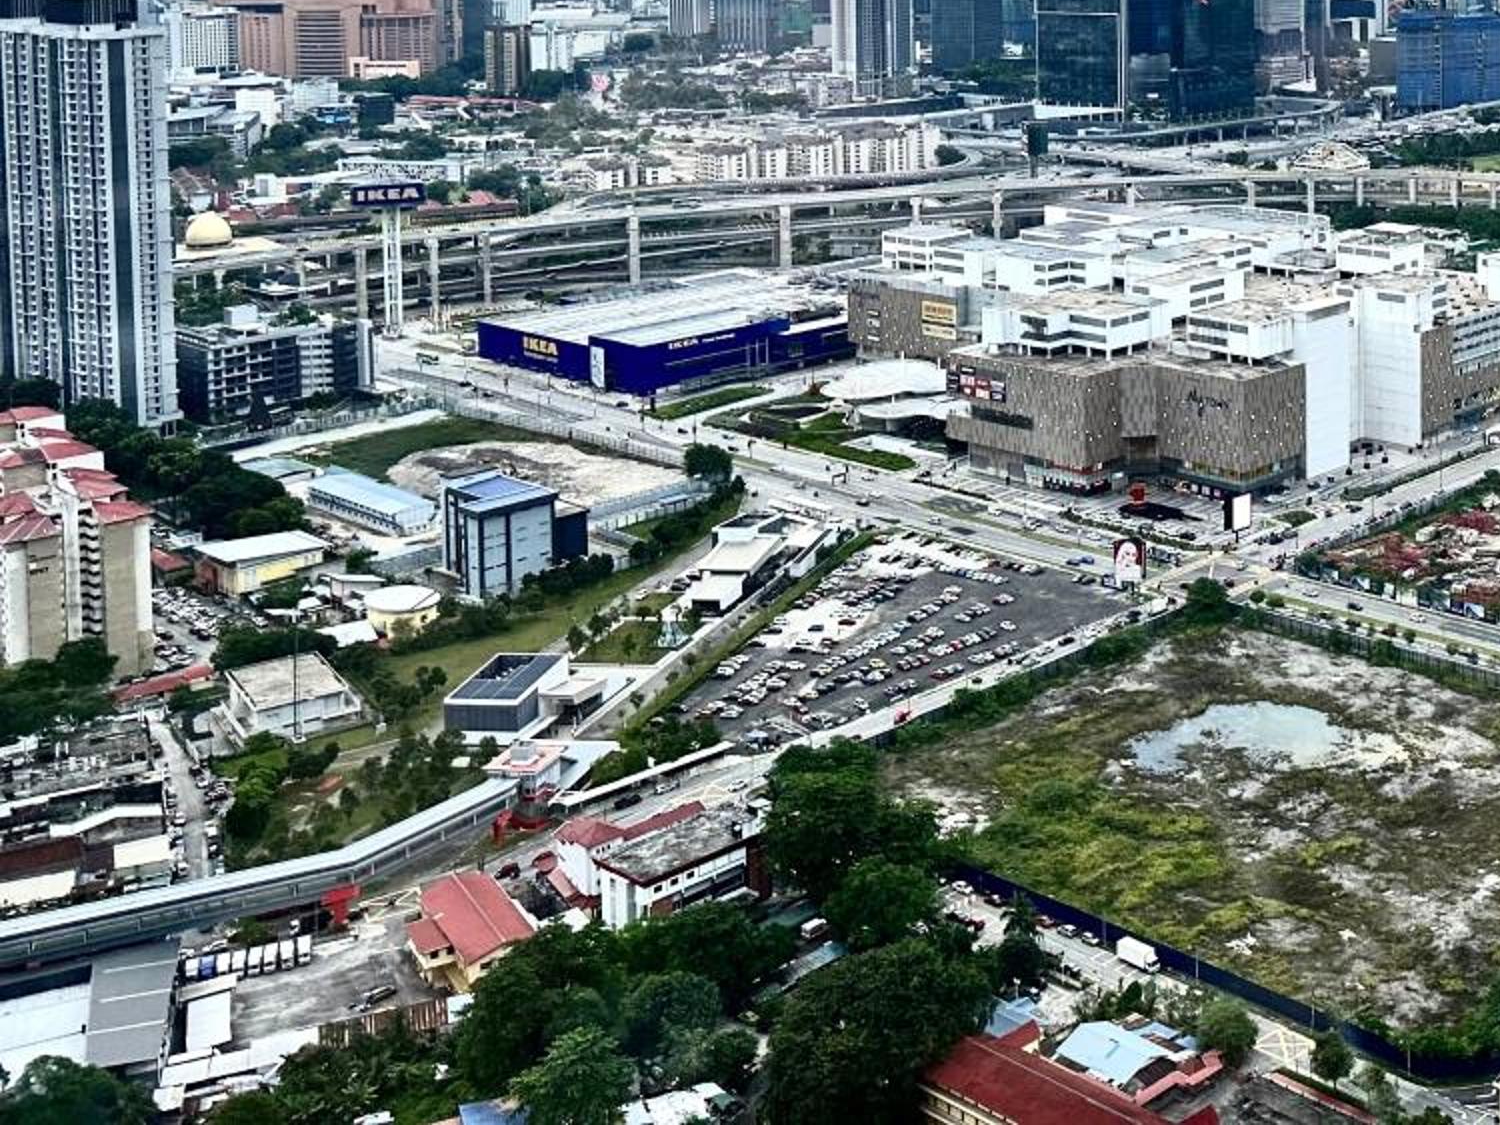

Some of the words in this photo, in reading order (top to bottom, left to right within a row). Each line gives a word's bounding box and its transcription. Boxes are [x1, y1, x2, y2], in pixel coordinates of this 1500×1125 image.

[357, 187, 419, 202] IKEA
[523, 336, 558, 355] IKEA
[668, 338, 699, 350] IKEA
